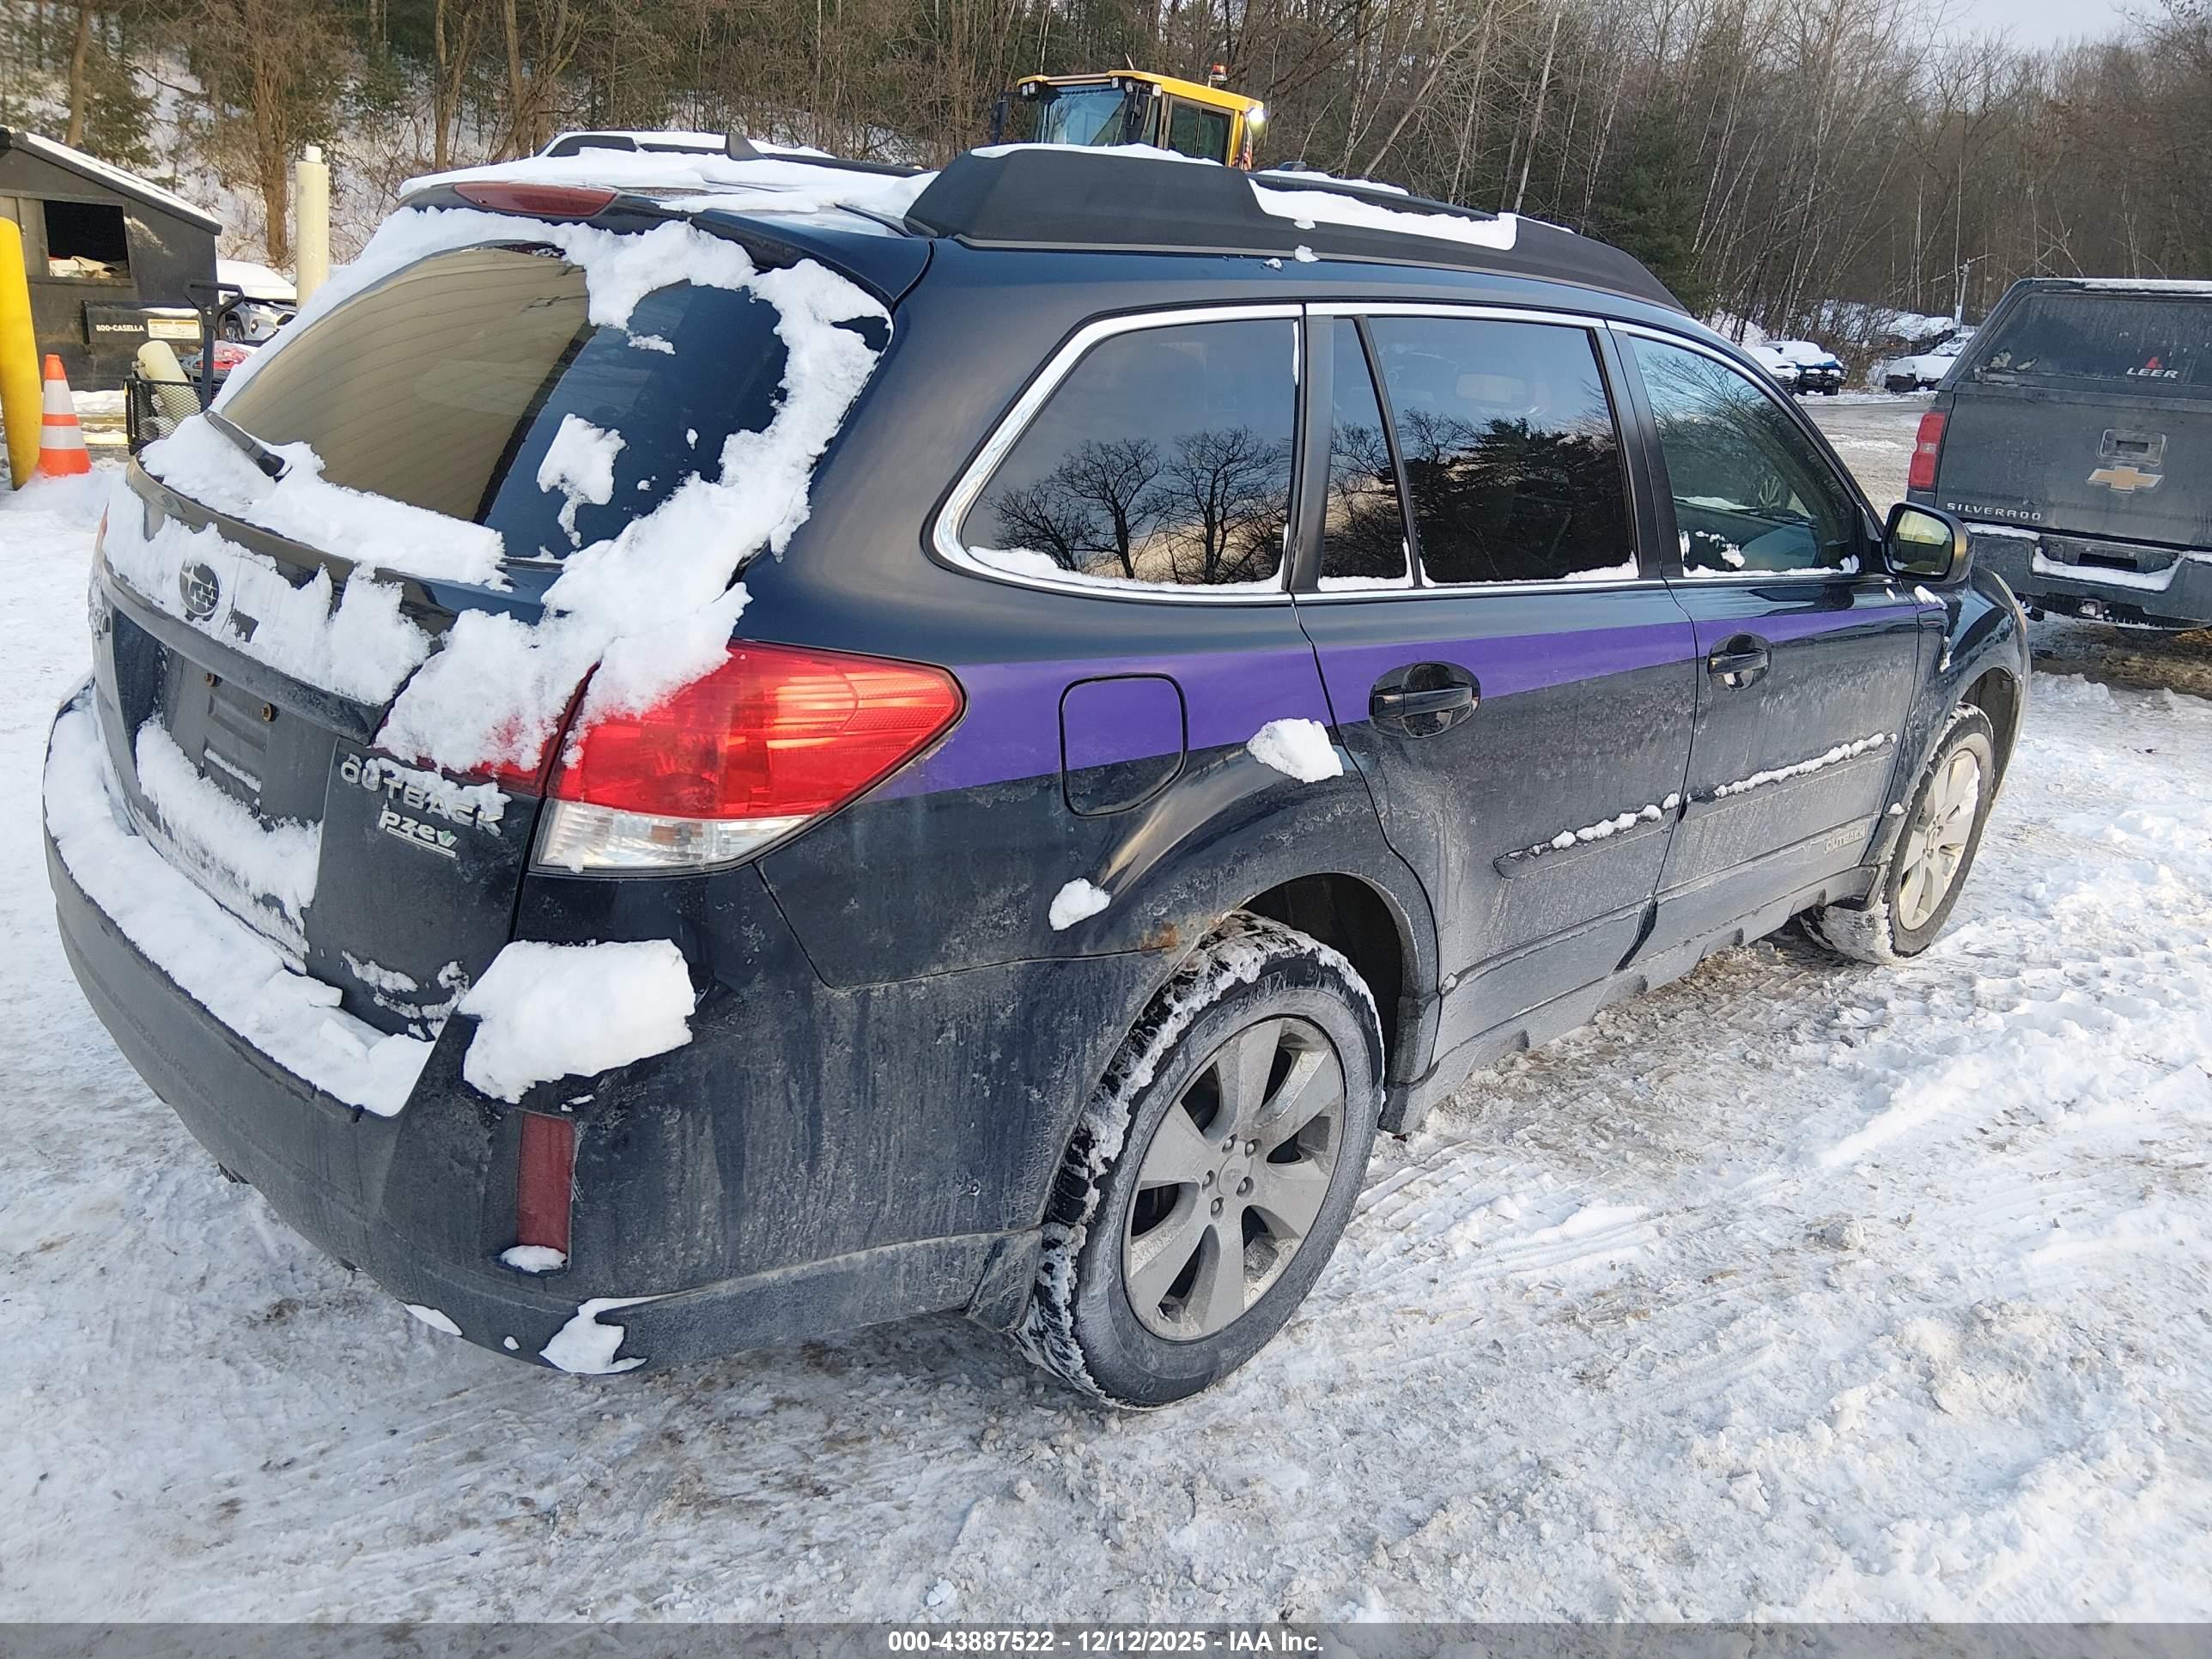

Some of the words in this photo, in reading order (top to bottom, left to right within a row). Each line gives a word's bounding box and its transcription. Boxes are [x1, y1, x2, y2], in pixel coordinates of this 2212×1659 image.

[2125, 367, 2179, 379] LEER
[1946, 502, 2042, 521] SILVERADO
[341, 761, 505, 837] OUTBACK
